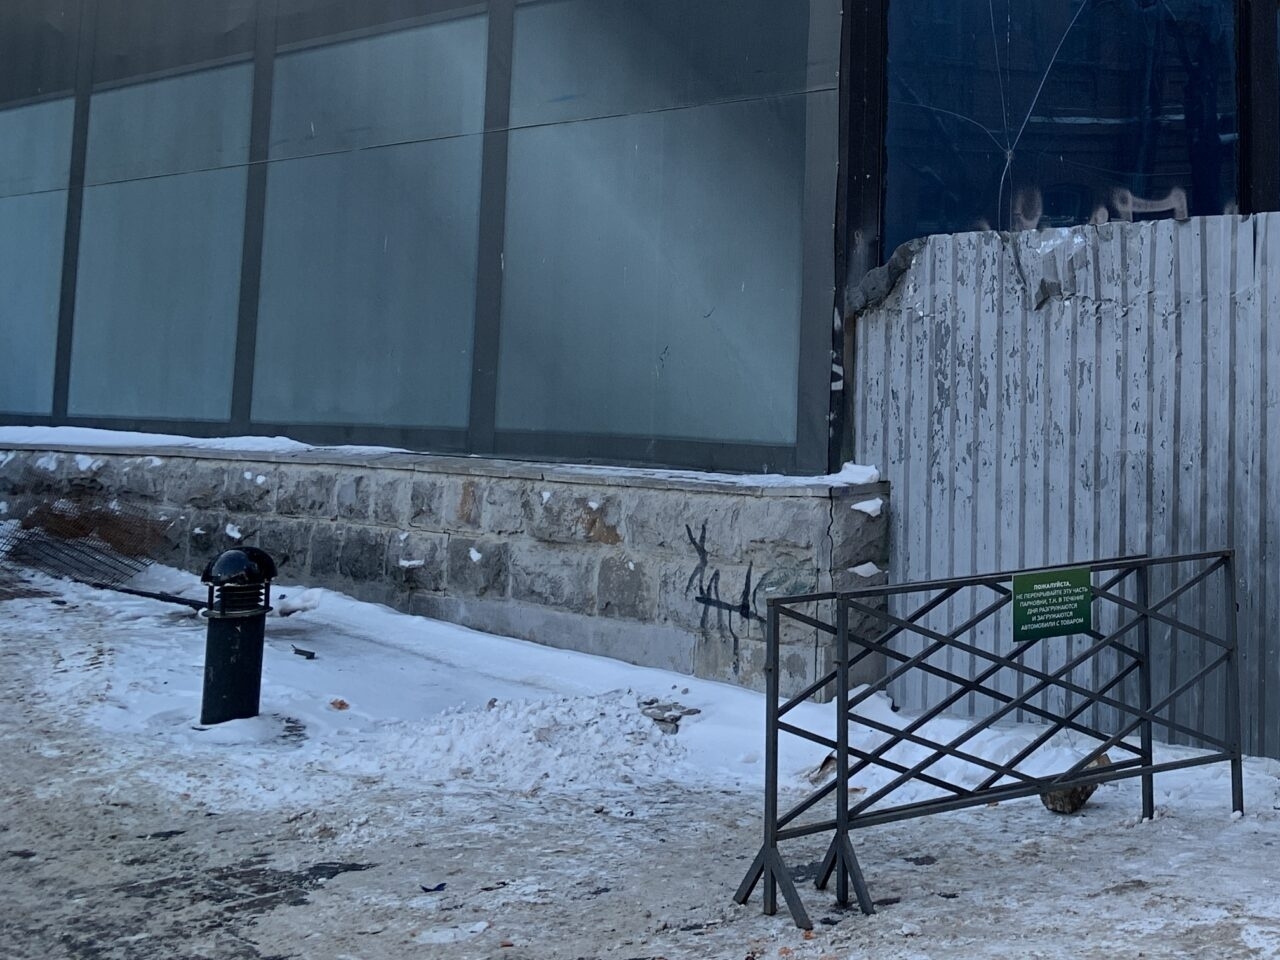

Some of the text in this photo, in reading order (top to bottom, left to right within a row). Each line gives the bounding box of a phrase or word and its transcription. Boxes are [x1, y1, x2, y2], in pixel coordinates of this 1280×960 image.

[1033, 581, 1071, 590] ПОЖАЛУЙСТА,
[1039, 603, 1078, 612] РАЗГРУЖАЮТСЯ
[1037, 611, 1073, 620] ЗАГРУЖАЮТСЯ
[1021, 621, 1055, 631] АВТОМОБИЛИ
[1060, 617, 1084, 626] ТОВАРОМ
